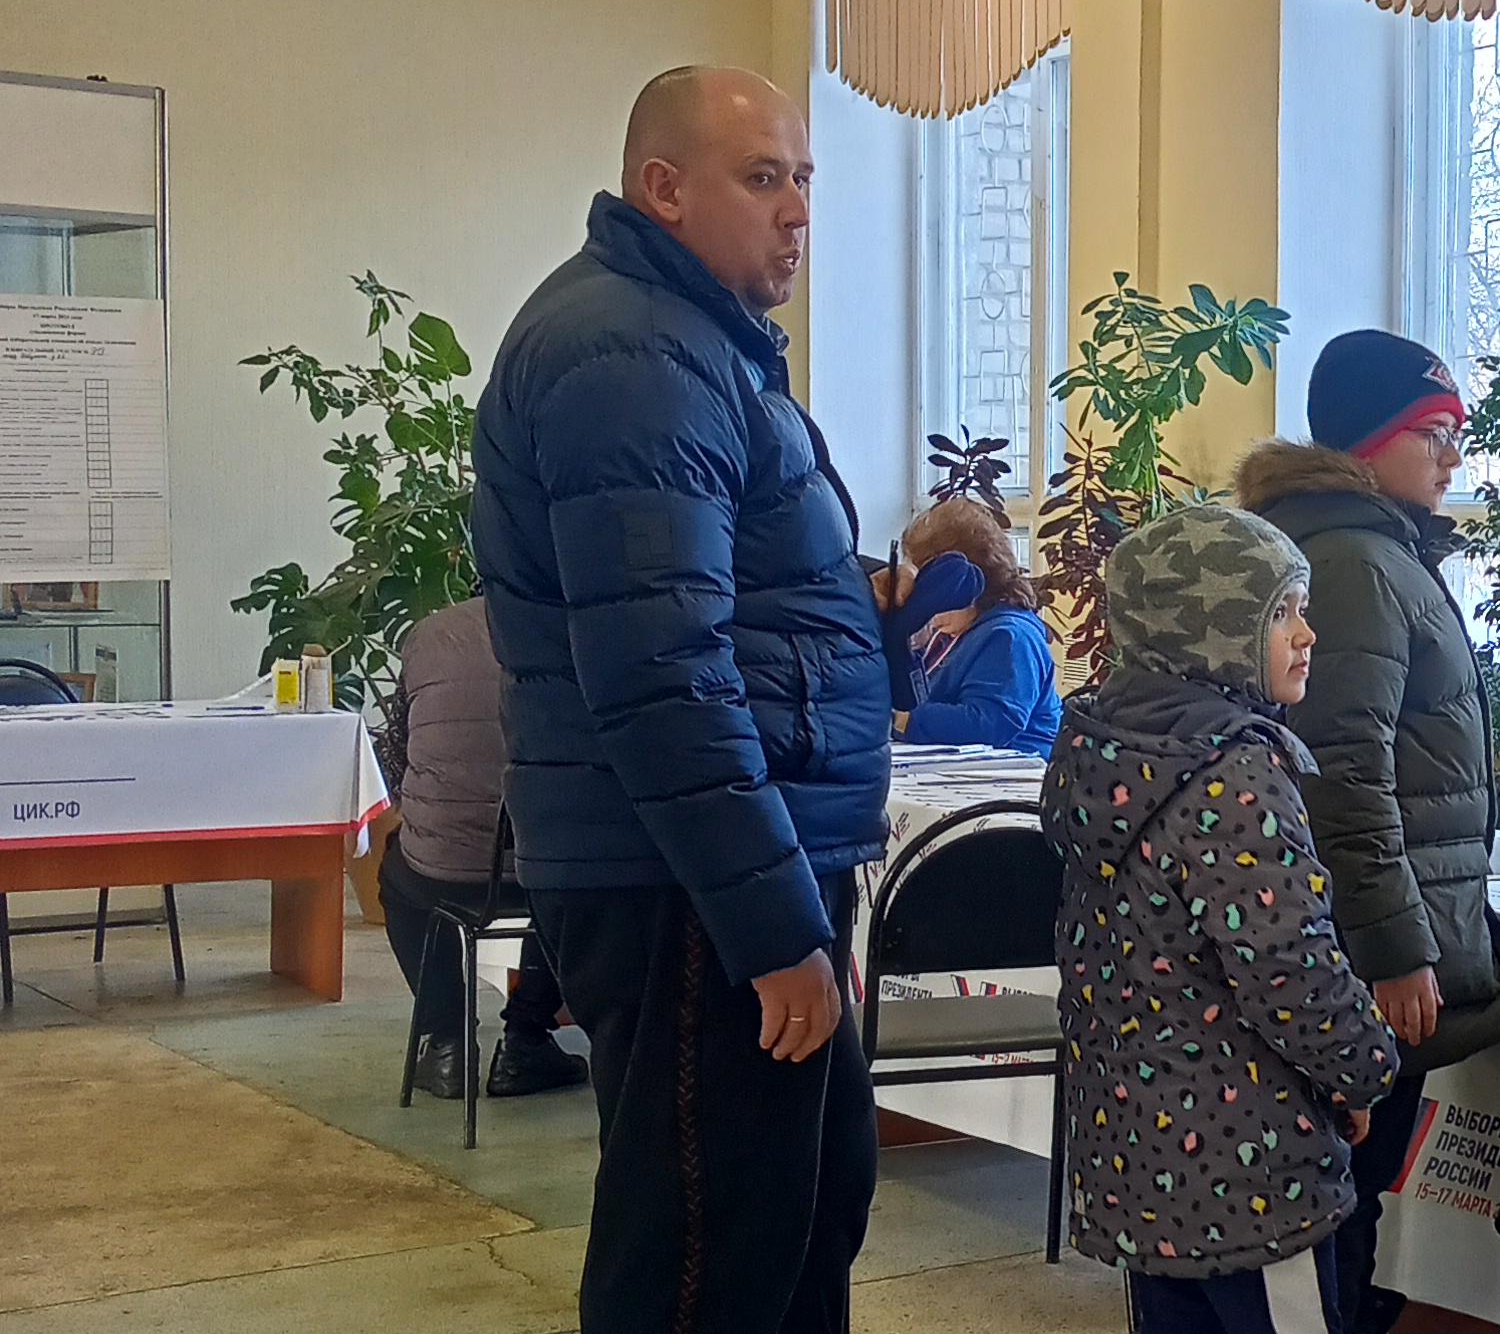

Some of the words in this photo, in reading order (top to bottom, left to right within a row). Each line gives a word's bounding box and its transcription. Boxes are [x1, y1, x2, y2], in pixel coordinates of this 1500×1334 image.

[13, 800, 81, 822] ЦИК.РФ
[1423, 1155, 1493, 1193] РОССИИ
[1451, 1190, 1493, 1218] МАРТА
